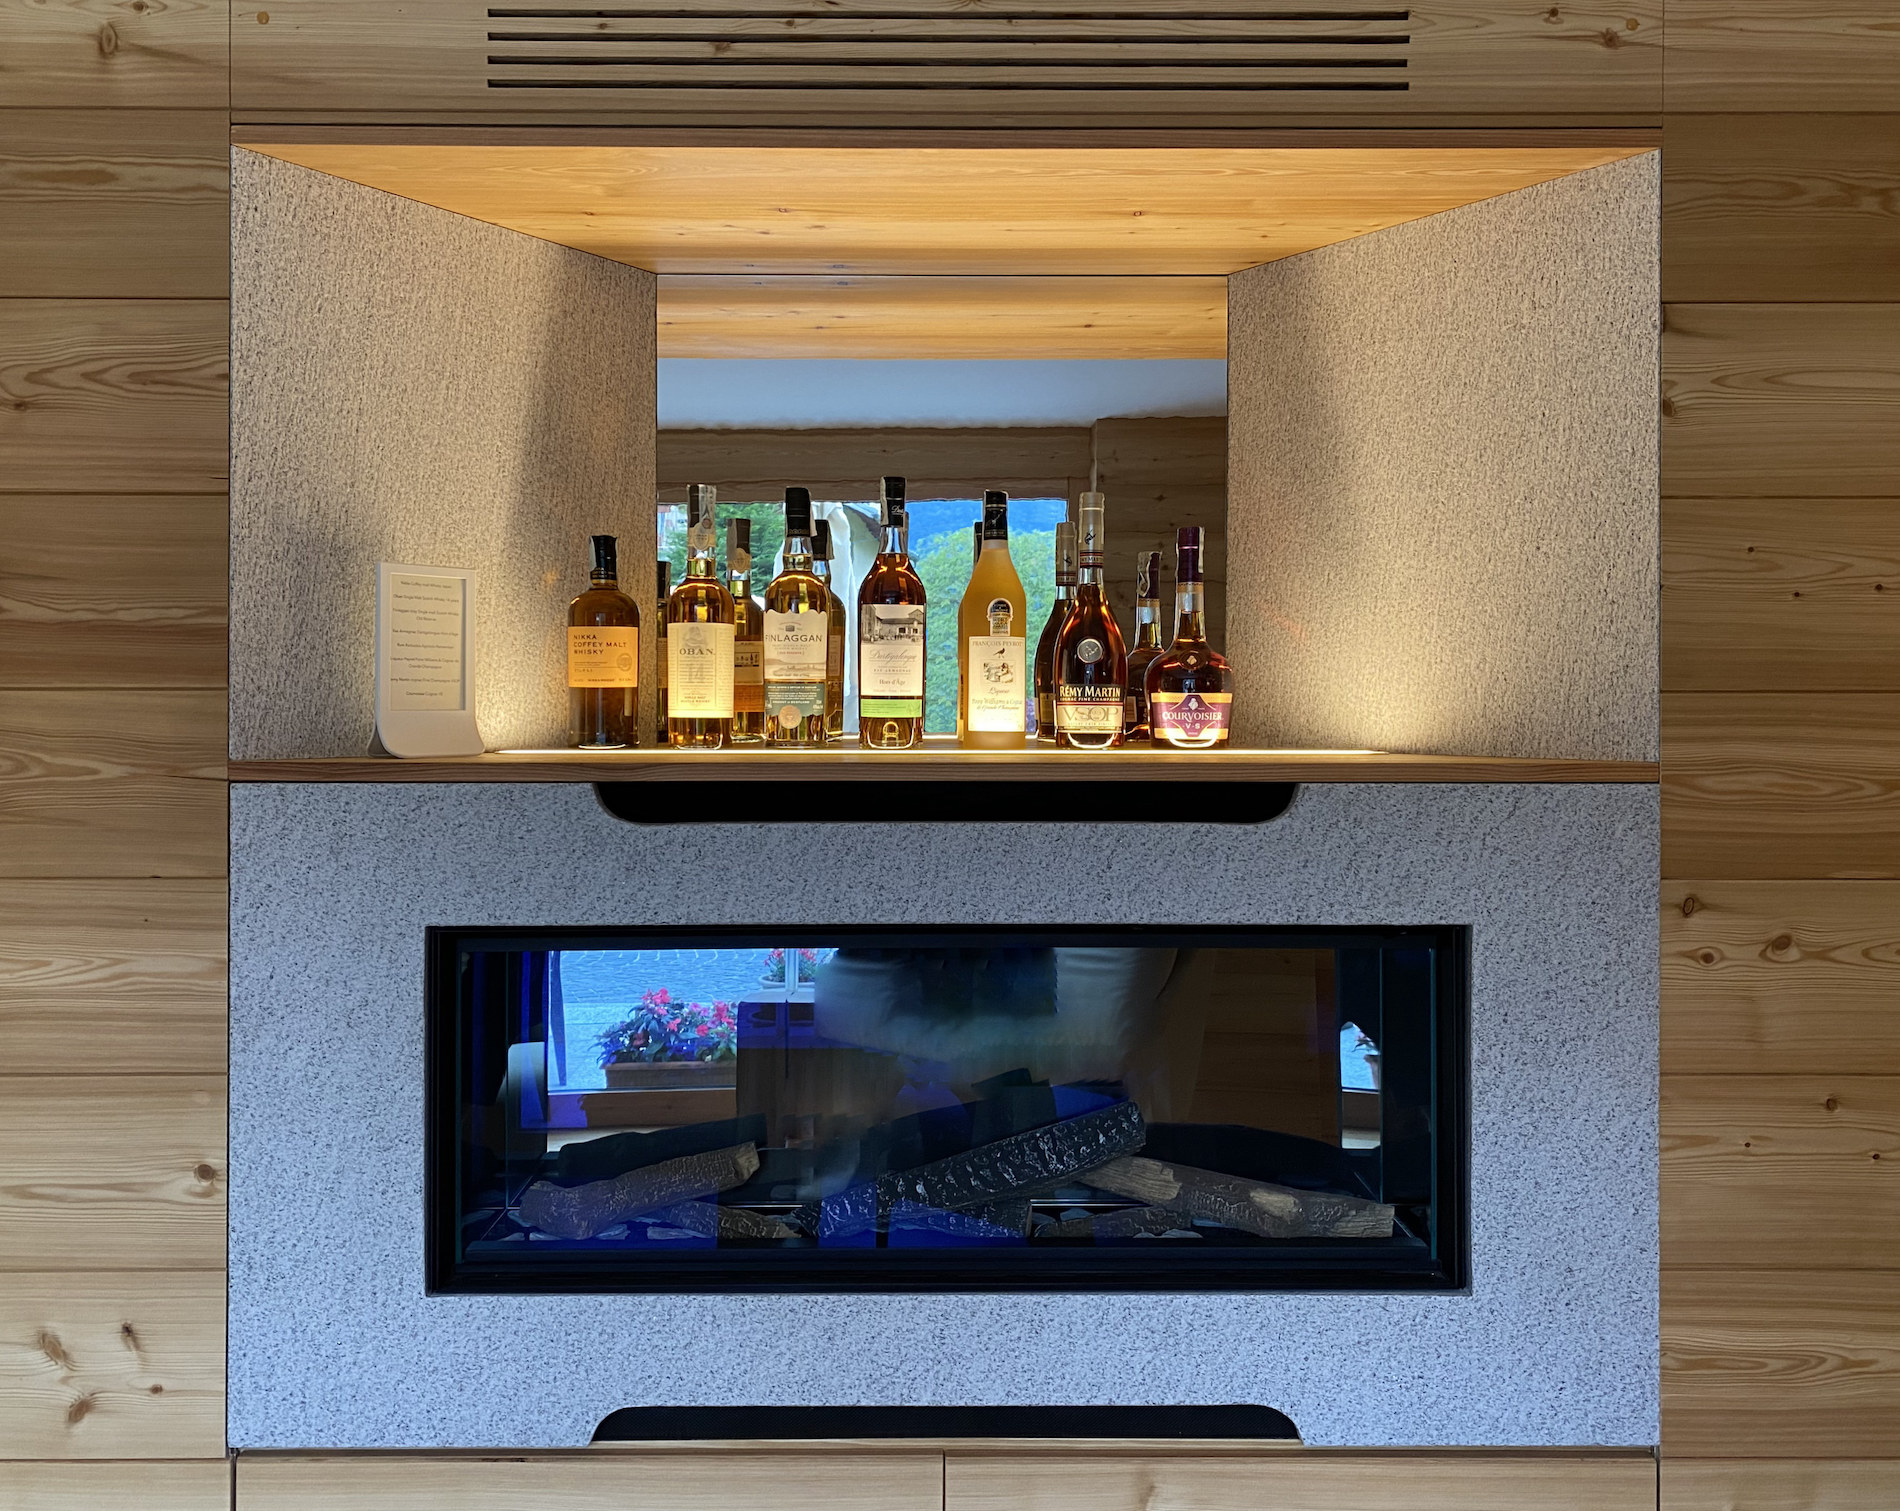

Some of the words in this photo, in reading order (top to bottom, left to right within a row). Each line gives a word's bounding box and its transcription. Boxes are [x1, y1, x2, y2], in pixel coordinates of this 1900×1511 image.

[765, 634, 822, 642] FINLAGGAN
[1059, 685, 1083, 697] RÉMY
[1084, 685, 1121, 697] MARTIN
[1162, 711, 1223, 723] COURVOISIER
